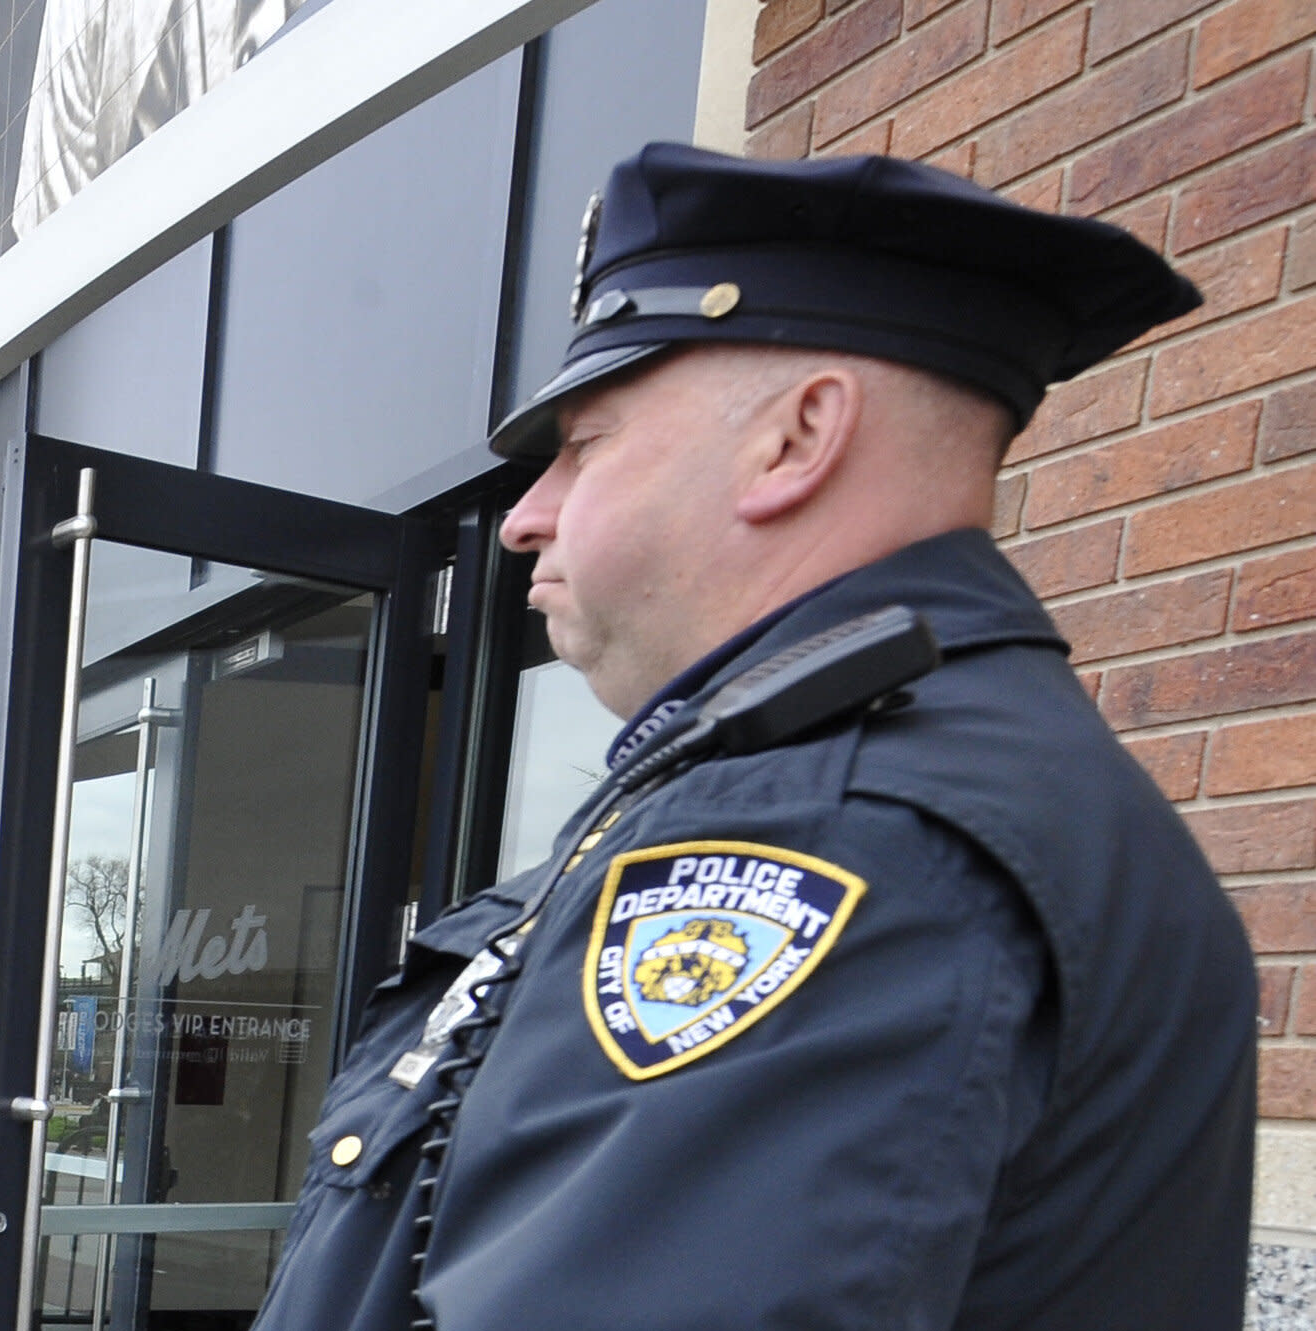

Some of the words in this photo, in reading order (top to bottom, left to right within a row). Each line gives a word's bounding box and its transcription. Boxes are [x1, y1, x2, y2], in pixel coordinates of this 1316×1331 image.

[667, 855, 804, 898] POLICE
[610, 883, 830, 939] DEPARTMENT
[153, 904, 268, 987] Mets
[598, 945, 624, 995] CITY
[734, 943, 811, 1005] YORK
[89, 1010, 164, 1034] ODGES
[172, 1013, 204, 1035] VIP
[210, 1015, 312, 1041] ENTRANCE
[604, 1000, 637, 1034] OF
[666, 1004, 736, 1055] NEW
